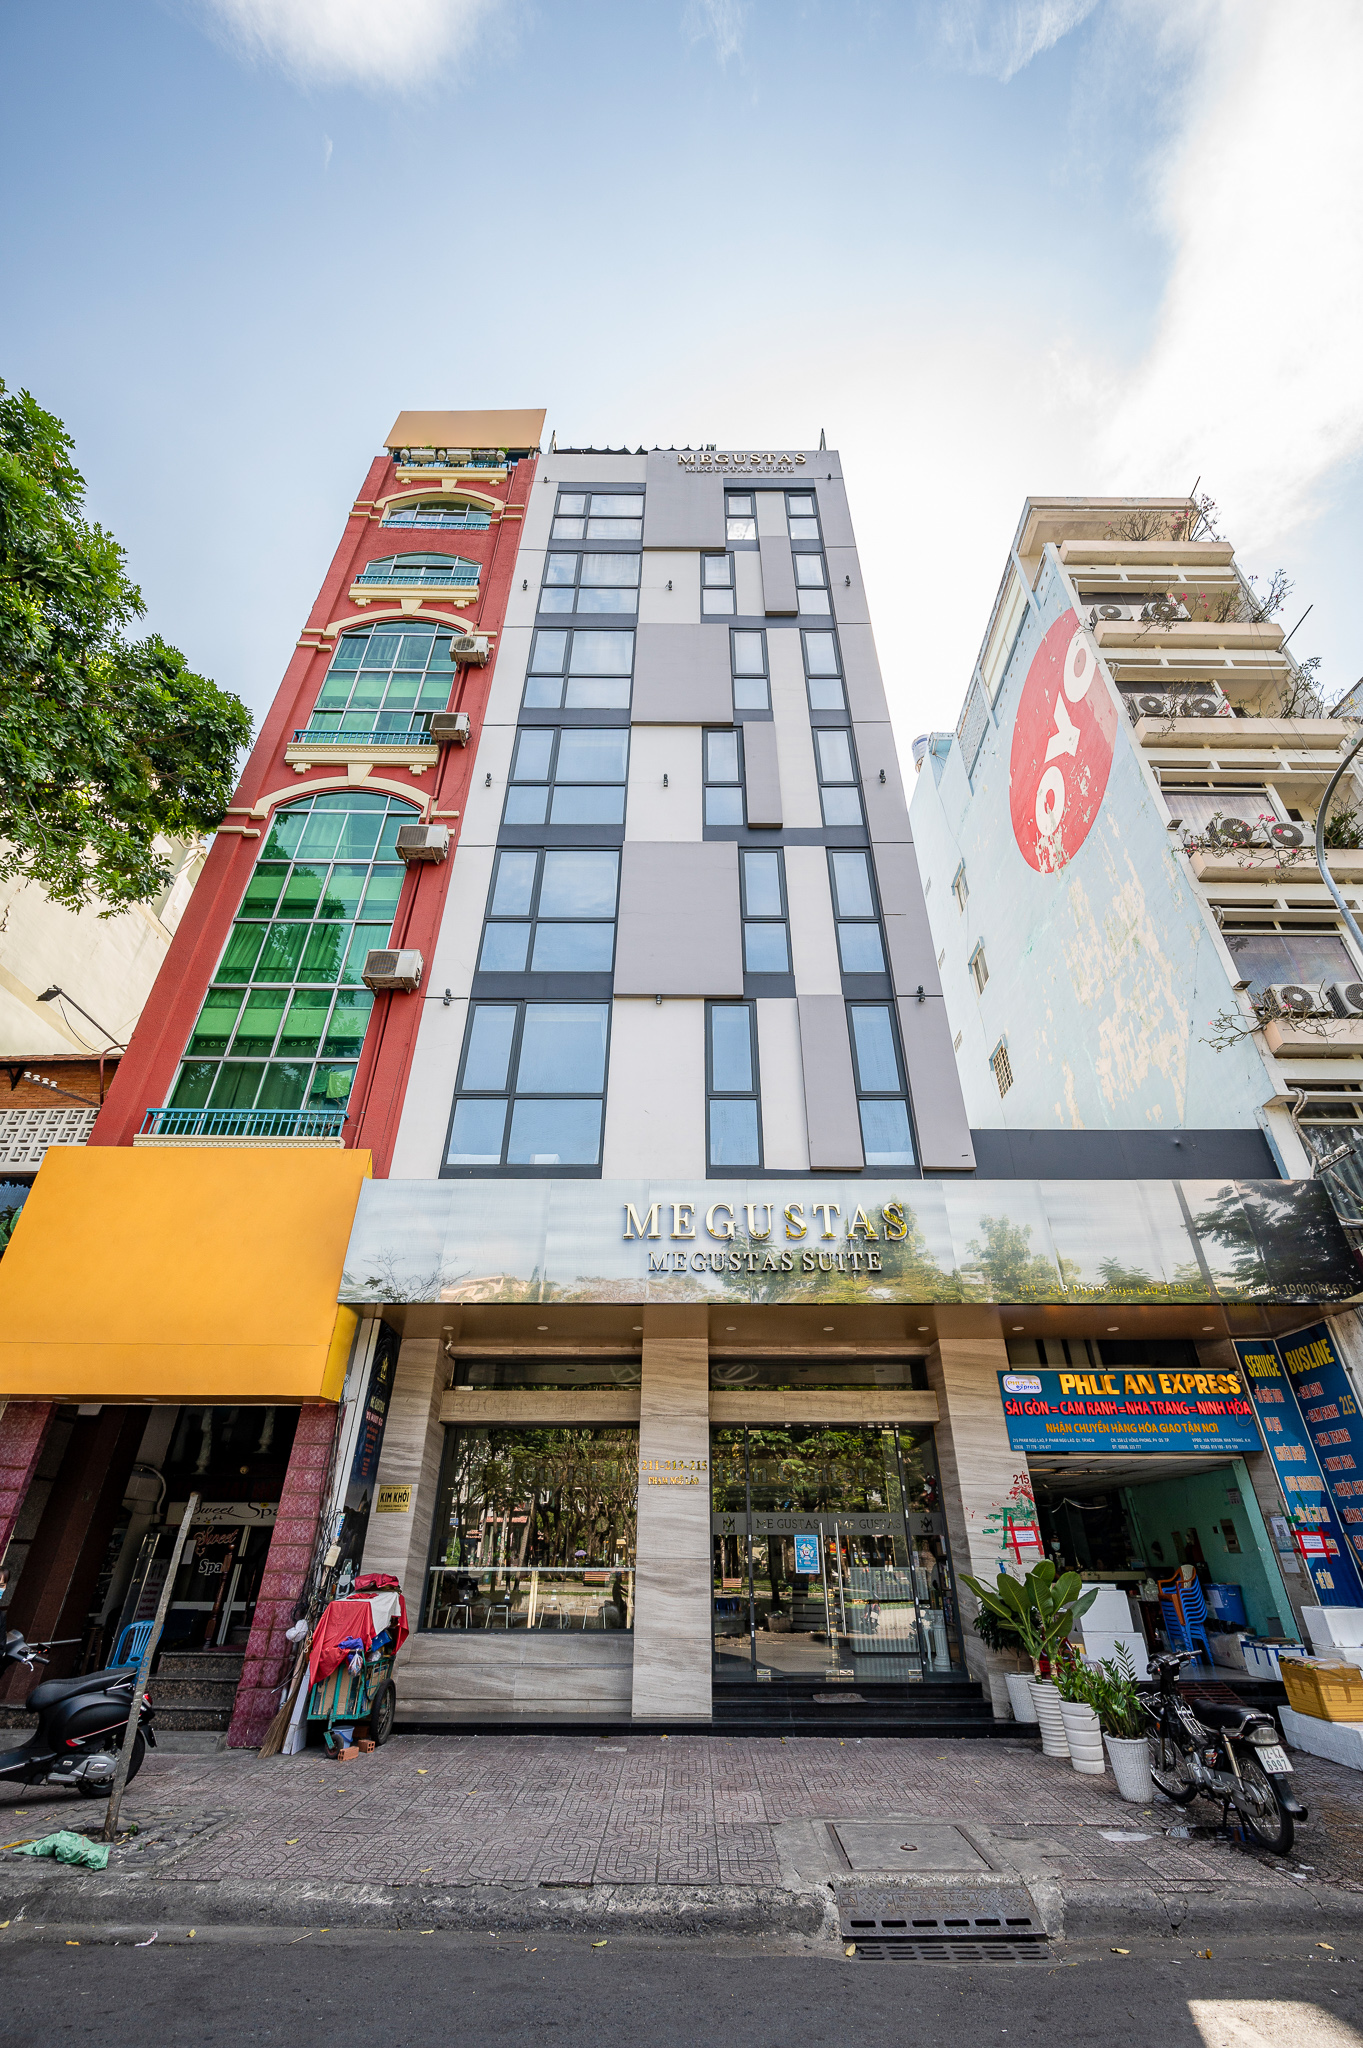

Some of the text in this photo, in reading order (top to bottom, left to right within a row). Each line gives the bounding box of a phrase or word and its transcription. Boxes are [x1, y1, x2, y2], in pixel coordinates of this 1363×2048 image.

[677, 453, 807, 465] MEGUSTAS
[685, 465, 795, 473] MEGUSTAS SUITE
[623, 1202, 909, 1242] MEGUSTAS
[648, 1251, 883, 1273] MEGUSTAS SUITE
[1284, 1338, 1335, 1375] BUSLINE
[1244, 1354, 1282, 1378] SERVICE
[1124, 1374, 1157, 1395] AN
[1157, 1373, 1242, 1395] EXPRESS
[1005, 1398, 1024, 1416] SÀI
[1024, 1398, 1050, 1416] GÒN
[1059, 1401, 1086, 1416] CAM
[1086, 1401, 1119, 1416] RANH
[1125, 1401, 1151, 1415] NHA
[1149, 1401, 1190, 1415] TRANG
[1196, 1401, 1226, 1415] NINH
[1225, 1397, 1253, 1415] HÒA
[1339, 1394, 1357, 1415] 215
[1112, 1420, 1137, 1433] HÀNG
[1138, 1421, 1159, 1433] HÓA
[1159, 1423, 1181, 1433] GIAO
[1181, 1421, 1202, 1435] TẬN
[1329, 1428, 1352, 1444] TRANG
[641, 1460, 708, 1471] 211-213-215
[1340, 1453, 1357, 1469] HOA
[1012, 1474, 1030, 1485] 215
[380, 1492, 393, 1503] KIM
[756, 1519, 774, 1529] ME
[777, 1518, 820, 1529] GUSTAS
[858, 1518, 901, 1529] GUSTAS
[193, 1526, 239, 1547] Sweet
[198, 1558, 223, 1576] Spa
[1266, 1758, 1289, 1771] 6997
